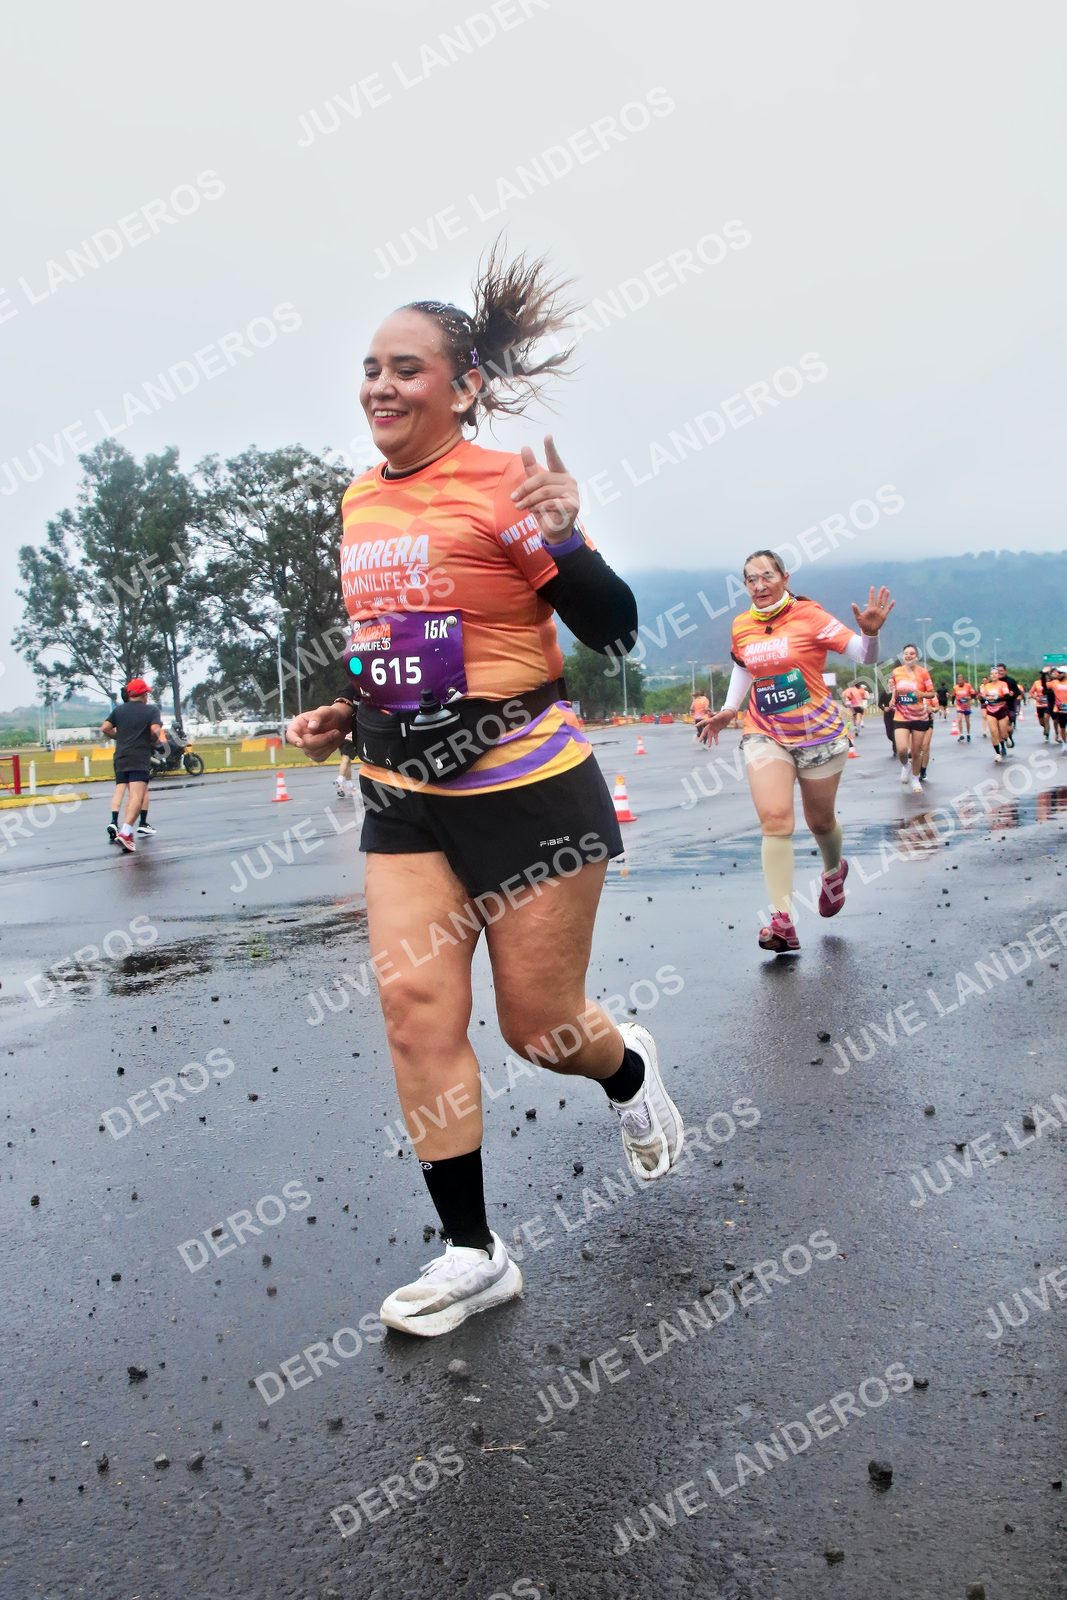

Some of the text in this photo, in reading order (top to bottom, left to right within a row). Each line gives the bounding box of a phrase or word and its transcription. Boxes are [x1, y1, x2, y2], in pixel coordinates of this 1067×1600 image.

[341, 535, 429, 577] CARRERA
[342, 571, 403, 598] OMNILIFE
[424, 619, 449, 640] 15K
[371, 656, 422, 686] 615
[764, 687, 797, 705] 1155
[540, 835, 570, 847] FIBER
